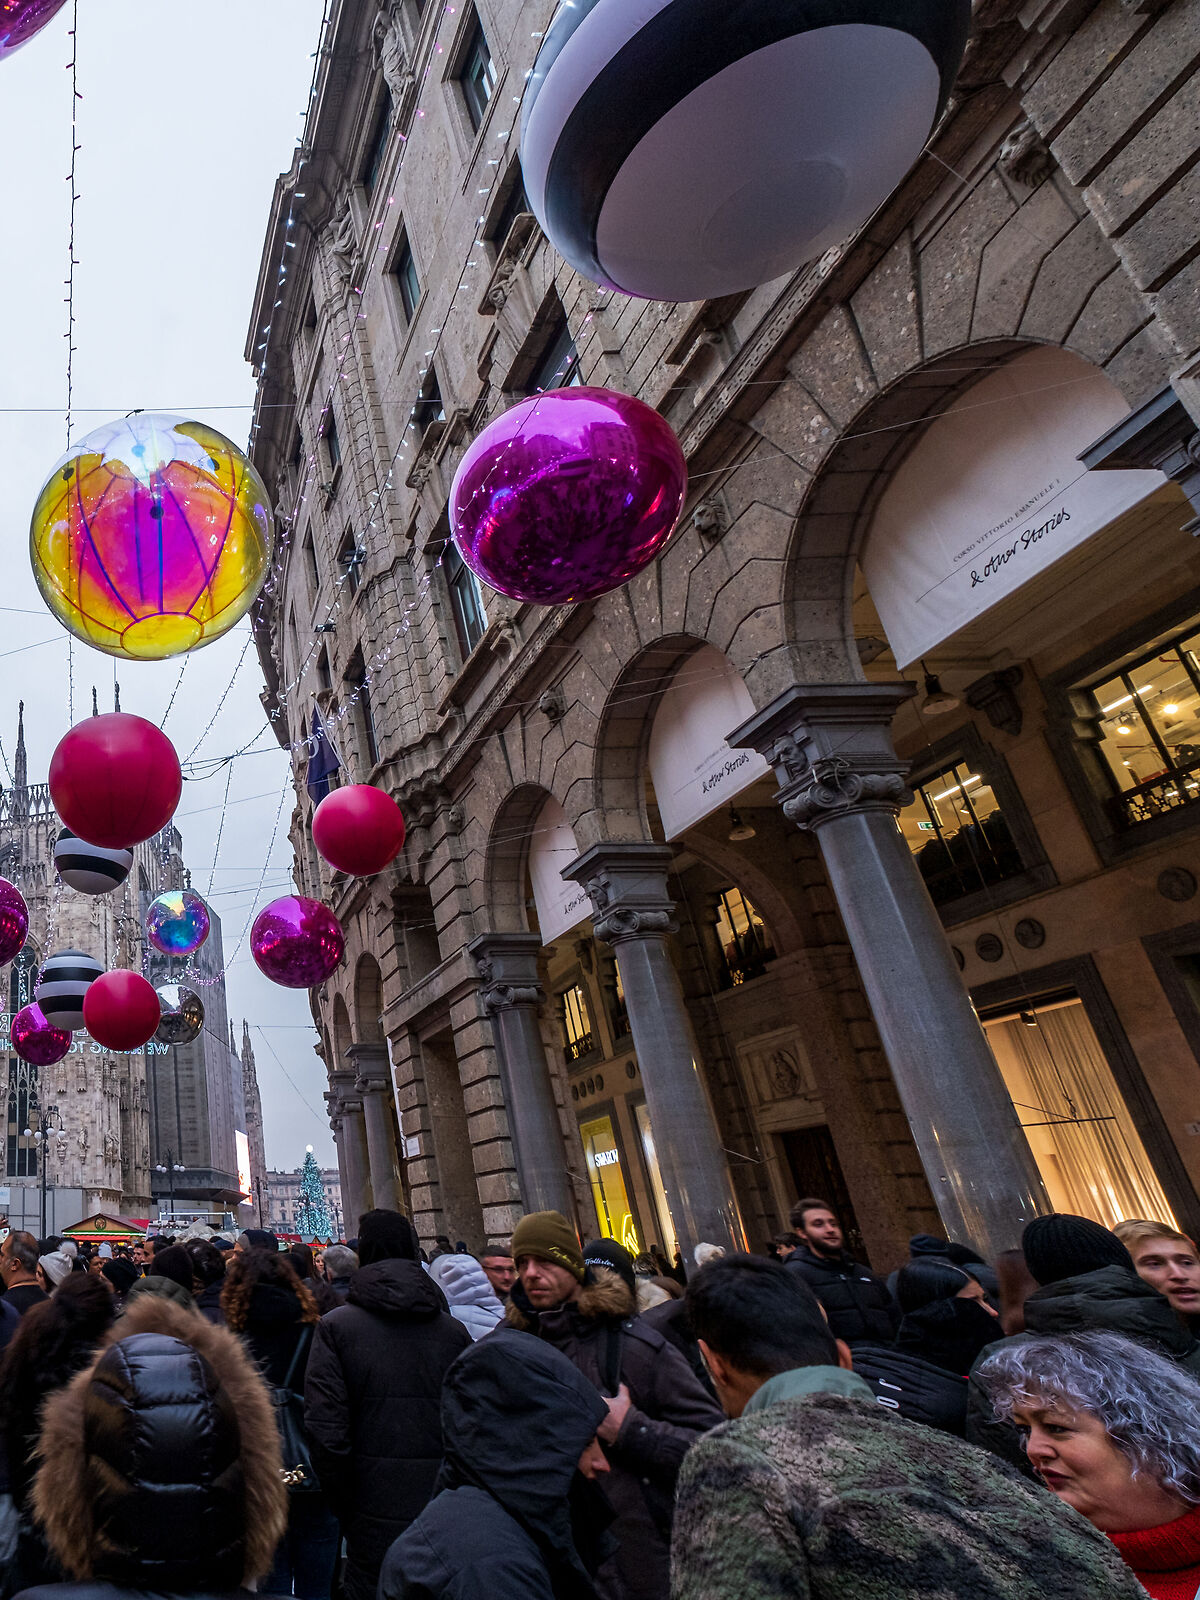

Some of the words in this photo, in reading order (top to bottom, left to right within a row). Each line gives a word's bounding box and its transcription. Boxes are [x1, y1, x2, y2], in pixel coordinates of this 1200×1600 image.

[953, 543, 976, 562] CORSO
[976, 516, 1014, 544] VITTORIO
[1014, 484, 1055, 518] EMANUELE
[970, 570, 985, 588] &
[984, 540, 1019, 577] other
[1020, 507, 1071, 550] Stories
